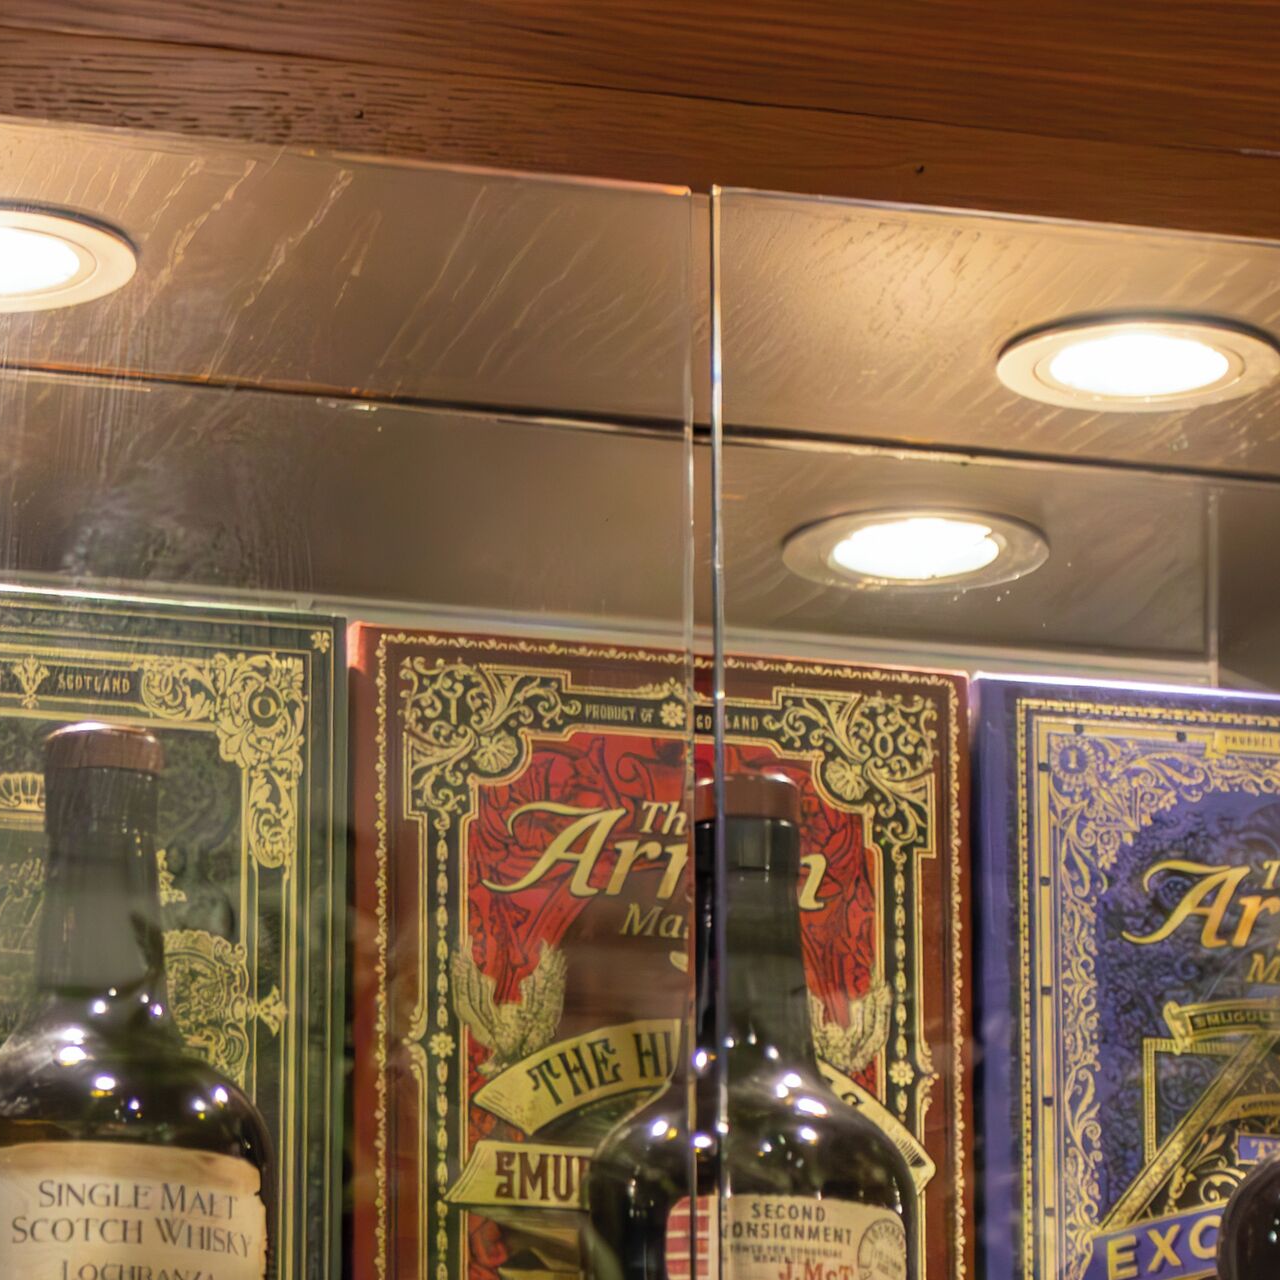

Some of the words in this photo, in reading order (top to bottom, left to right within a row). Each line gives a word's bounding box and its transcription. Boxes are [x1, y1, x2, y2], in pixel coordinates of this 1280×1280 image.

[57, 670, 131, 694] SCOTLAND
[585, 703, 637, 721] PRODUCT
[639, 706, 656, 724] OF
[691, 713, 760, 733] COLAND
[640, 800, 688, 837] Th
[481, 800, 827, 911] Arrn
[620, 902, 688, 941] Ma
[526, 1036, 622, 1106] THE
[38, 1179, 152, 1212] SINGLE
[160, 1182, 239, 1220] MALT
[751, 1203, 826, 1222] SECOND
[11, 1216, 143, 1245] SCOTCH
[155, 1217, 253, 1258] WHISKY
